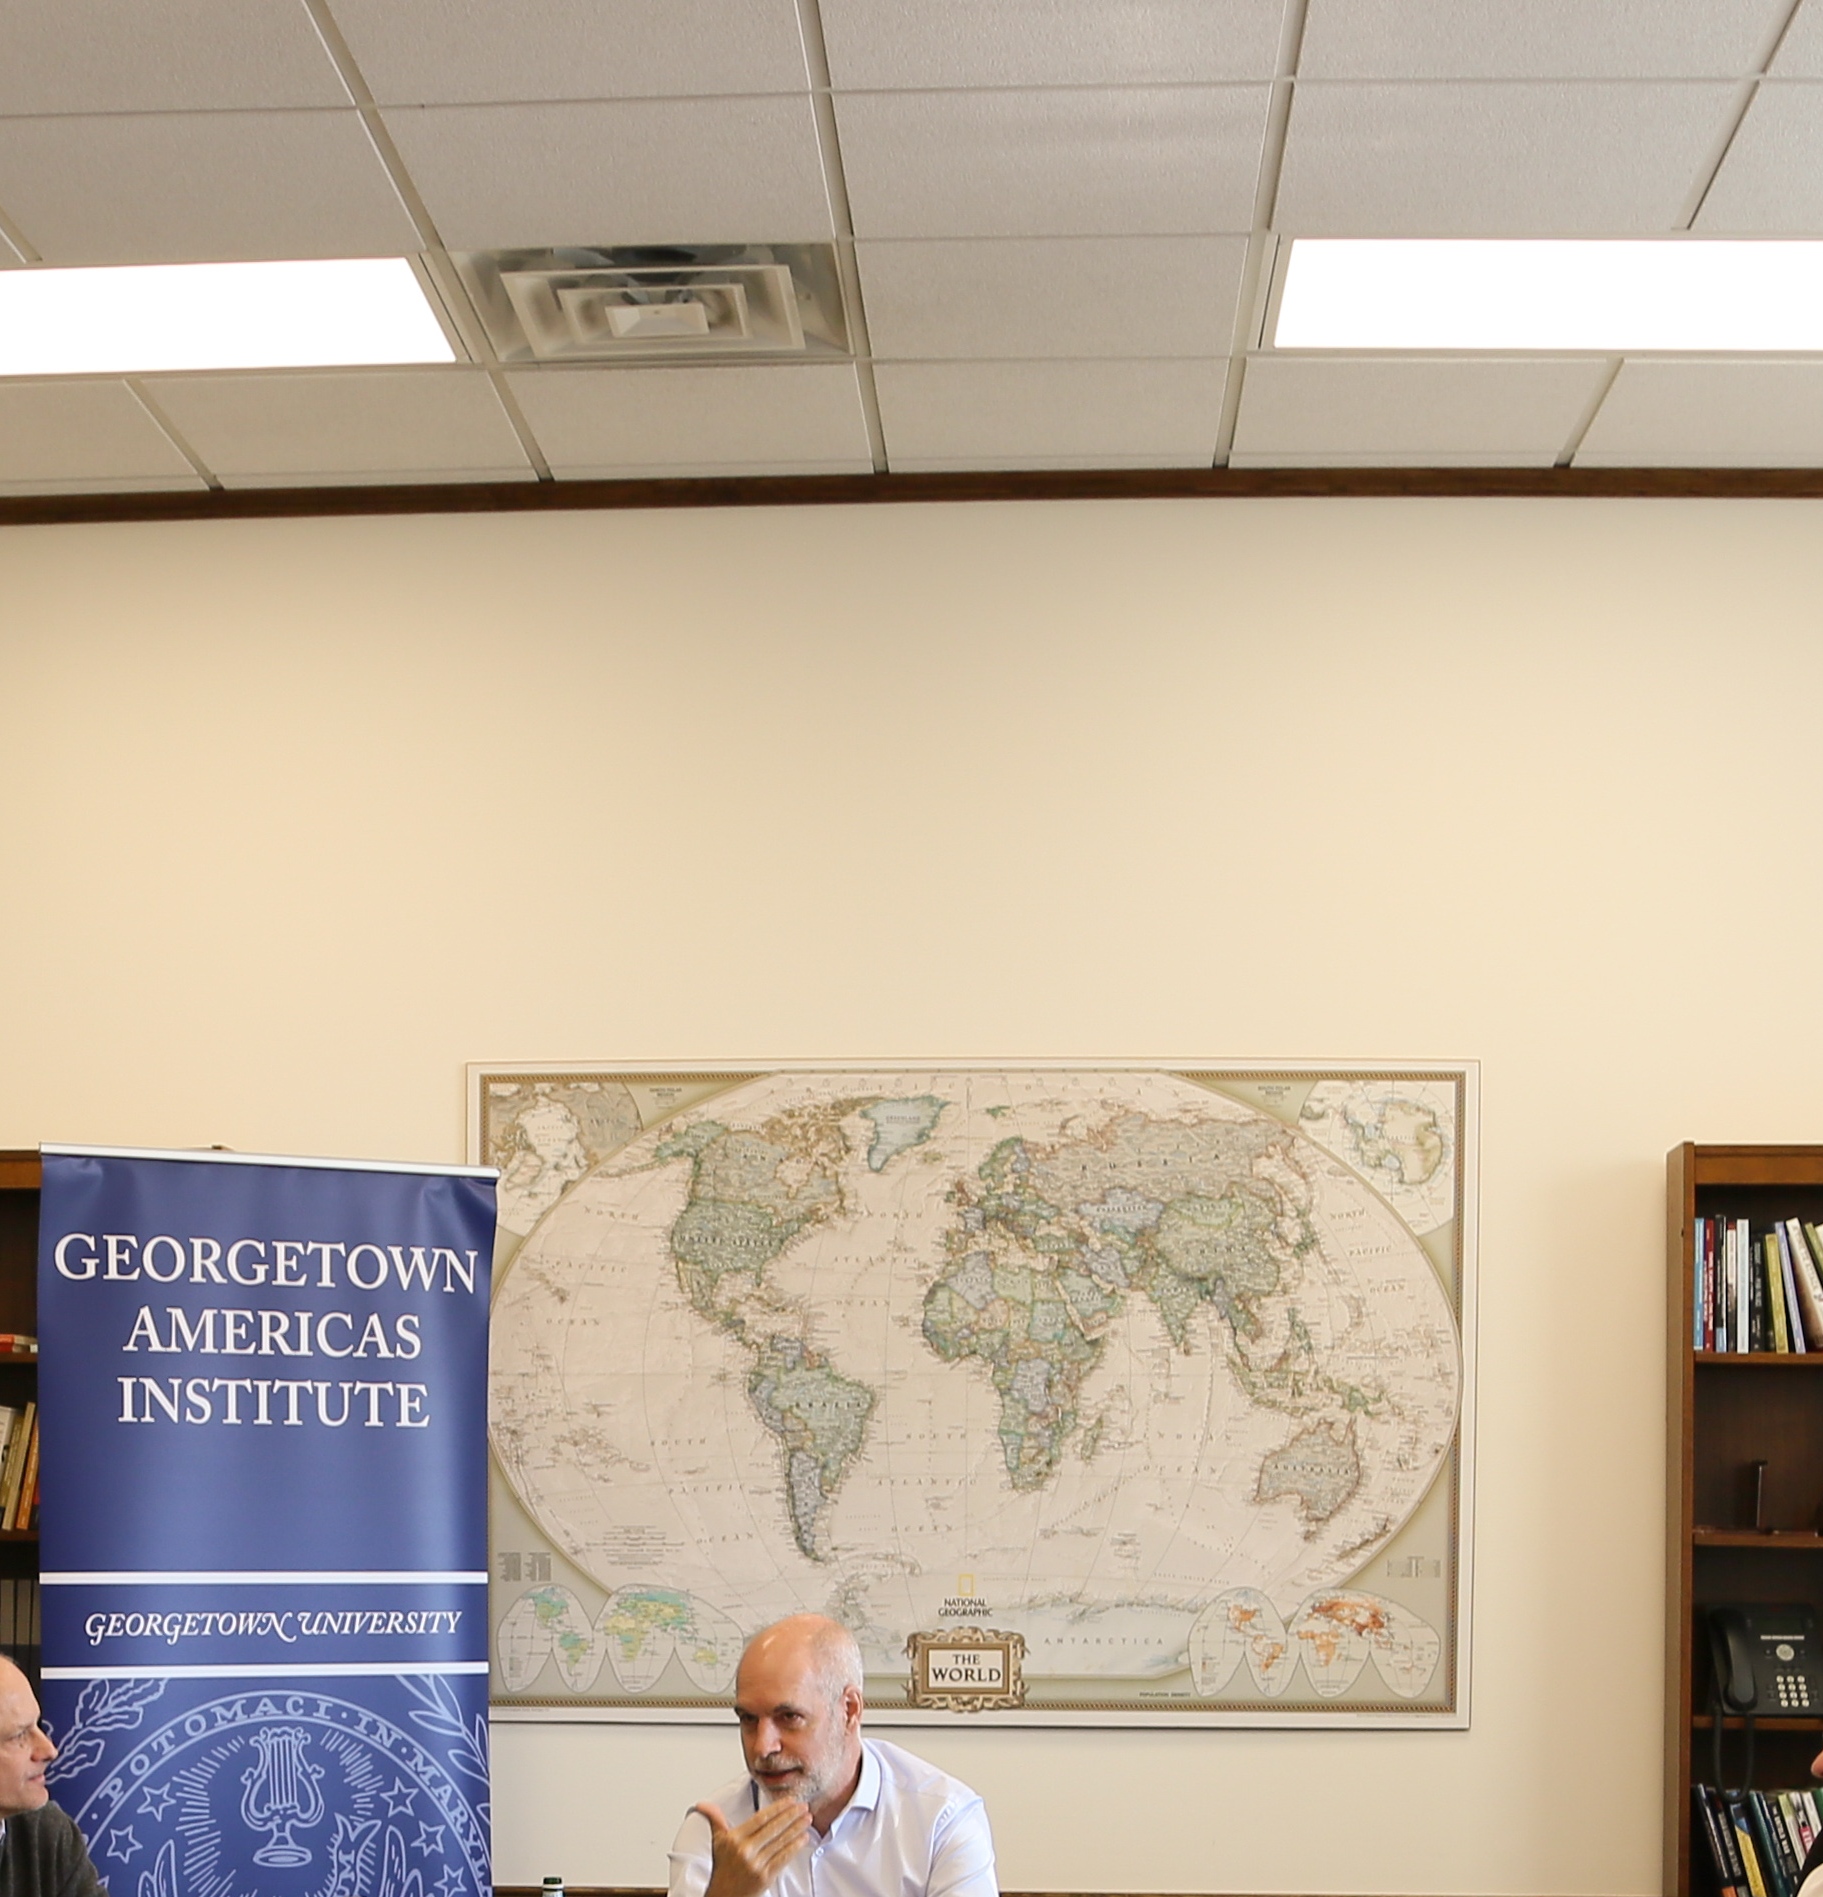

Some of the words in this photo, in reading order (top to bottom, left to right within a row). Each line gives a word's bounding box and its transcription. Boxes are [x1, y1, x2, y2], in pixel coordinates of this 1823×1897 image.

[584, 1206, 639, 1221] NORTH
[1330, 1208, 1366, 1220] NORTH
[54, 1233, 478, 1294] GEORGETOWN
[122, 1305, 422, 1359] AMERICAS
[117, 1377, 431, 1428] INSTITUTE
[1274, 1463, 1350, 1475] AUSTRALIA
[944, 1598, 987, 1606] NATIONAL
[938, 1608, 993, 1617] GEOGRAPHIC
[84, 1611, 297, 1645] GEORGETOWN
[298, 1610, 462, 1635] UNIVERSITY
[1044, 1637, 1164, 1646] ANTARCTICA
[953, 1654, 981, 1665] THE
[932, 1667, 1001, 1682] WORLD
[99, 1695, 333, 1808] POTOMACI
[354, 1712, 402, 1749] IN
